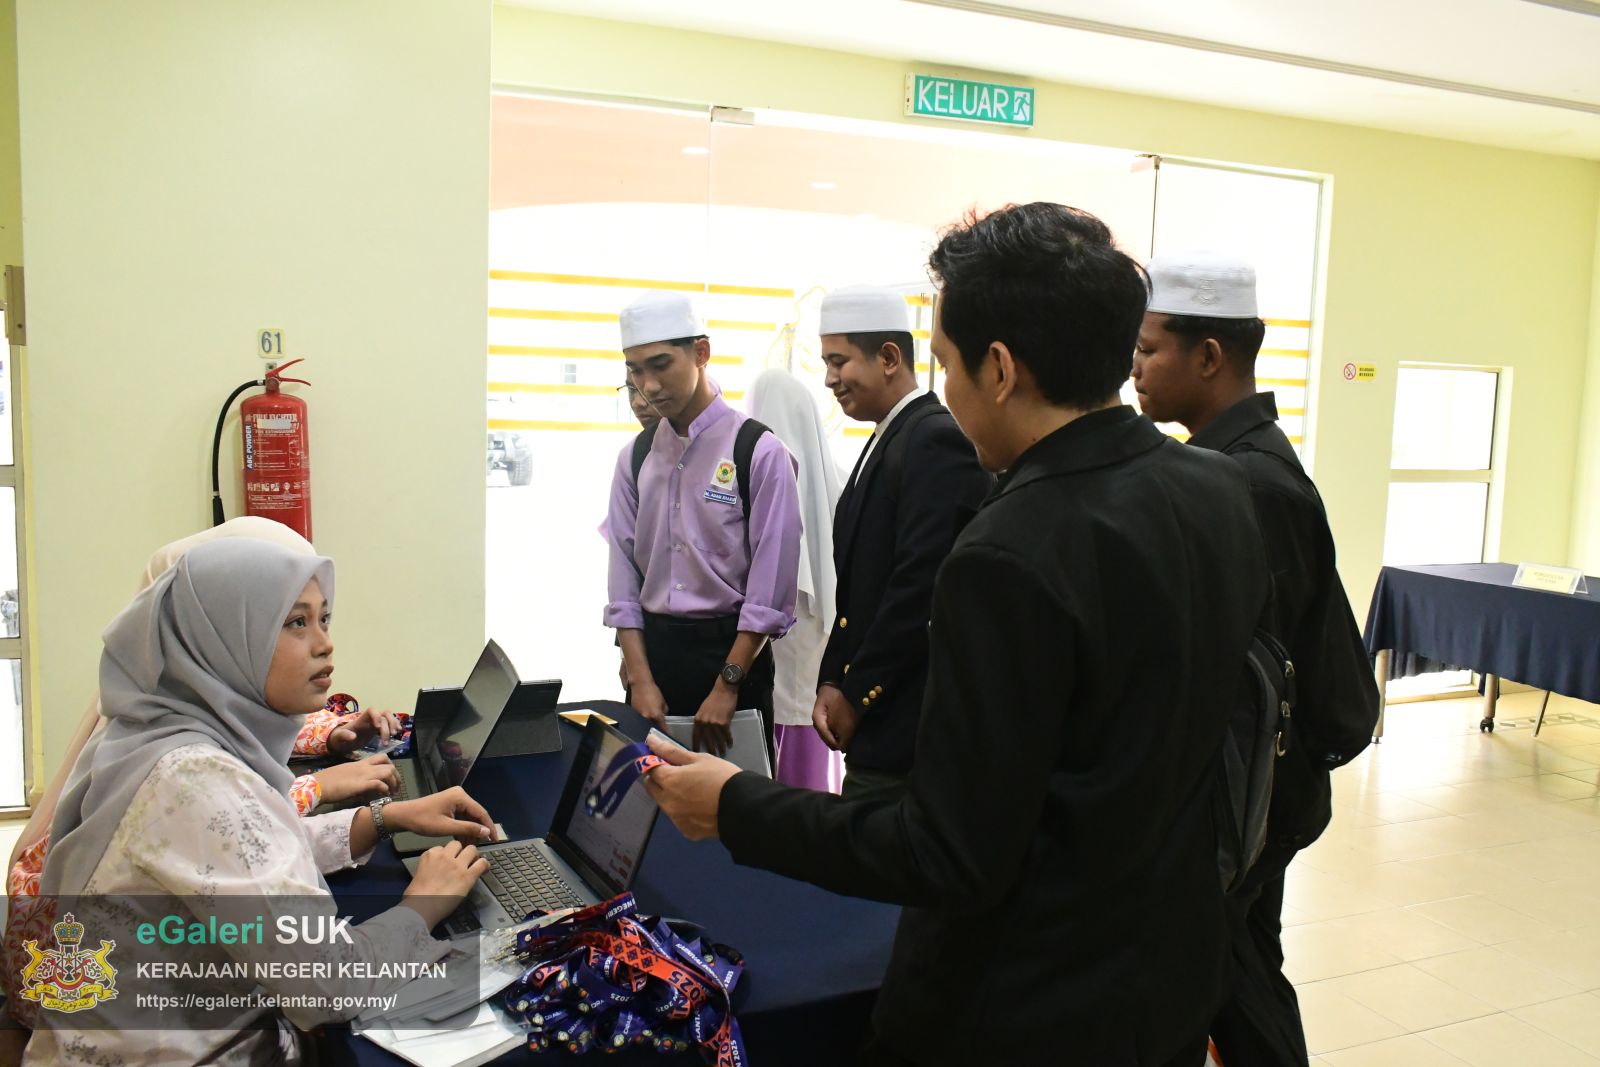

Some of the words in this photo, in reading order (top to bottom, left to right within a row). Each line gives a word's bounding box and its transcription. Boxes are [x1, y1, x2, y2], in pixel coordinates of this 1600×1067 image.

[918, 79, 1009, 119] KELUAR
[261, 331, 283, 353] 61
[245, 425, 253, 454] POWDER
[731, 1040, 740, 1060] 2025
